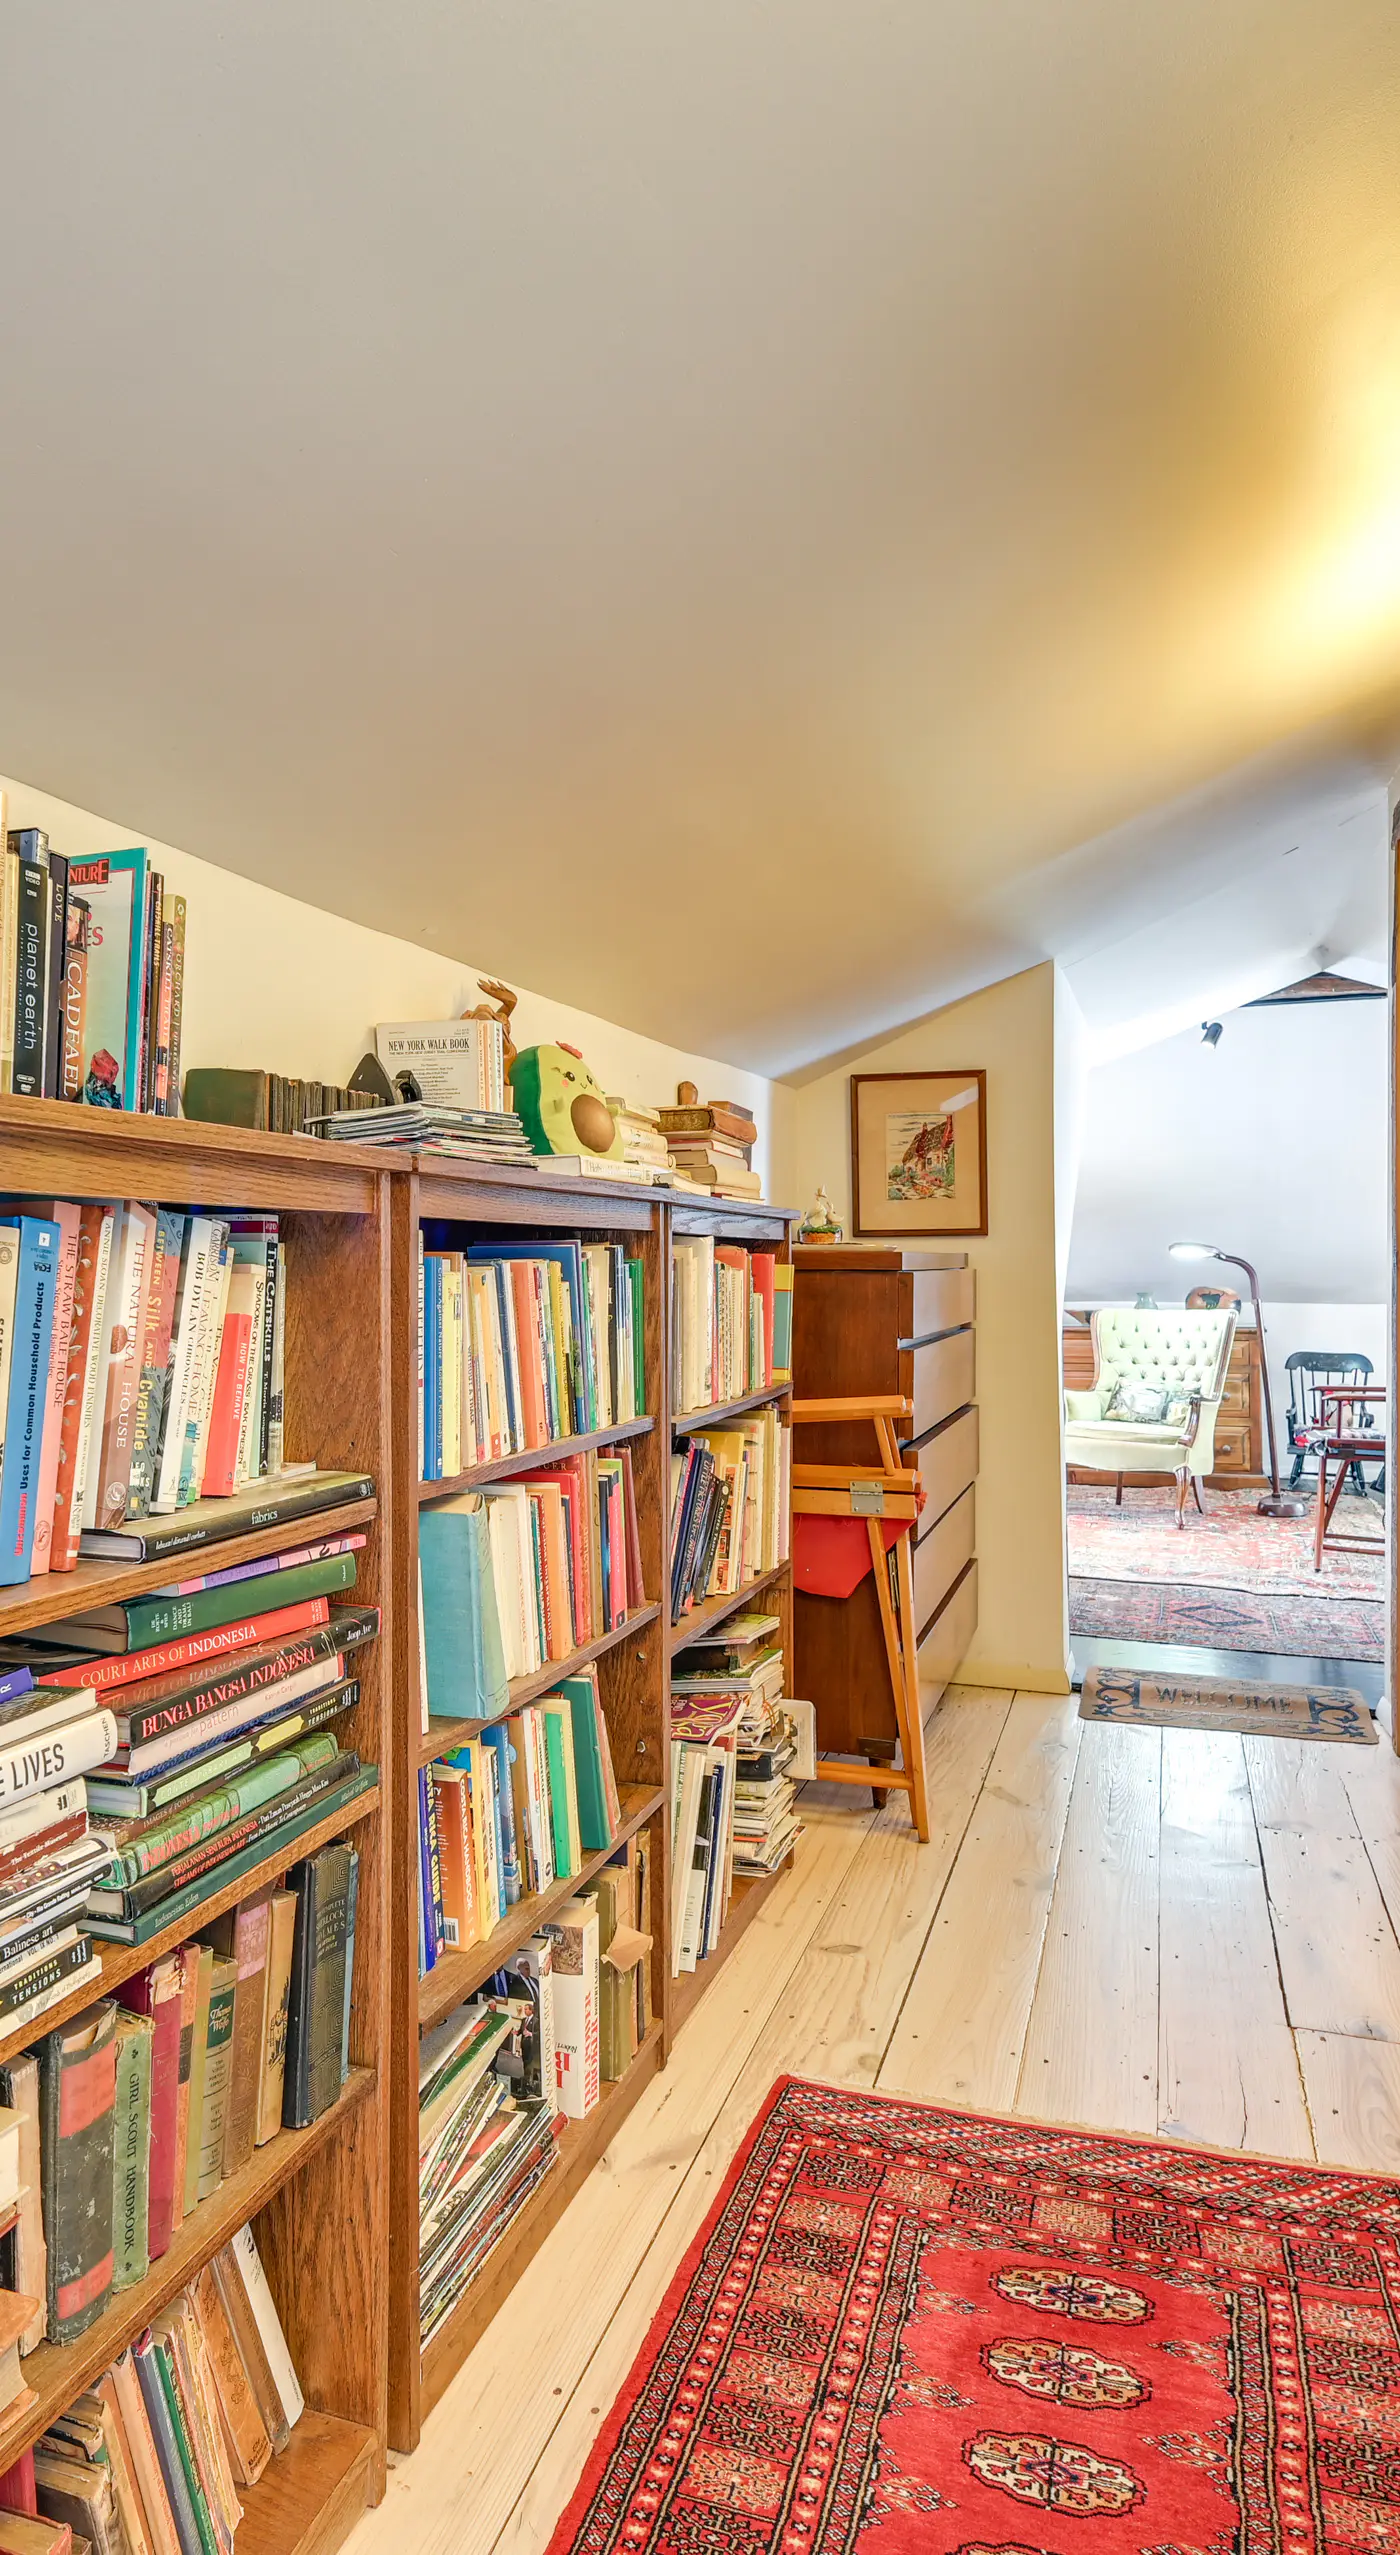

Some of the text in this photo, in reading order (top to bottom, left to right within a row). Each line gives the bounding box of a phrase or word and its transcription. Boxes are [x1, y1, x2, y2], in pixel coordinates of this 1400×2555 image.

[25, 877, 40, 885] VIDEO
[54, 883, 64, 923] LOVE
[153, 900, 162, 966] CATSKILL TRAILS
[163, 928, 173, 993] CATSKILL
[24, 923, 40, 1049] planet earth
[172, 953, 184, 1017] ORCHARD
[64, 961, 82, 1096] CADFAEL
[388, 1037, 470, 1052] NEW YORK WALK BOOK
[207, 1227, 222, 1280] GARRISON
[266, 1247, 277, 1277] THE
[51, 1314, 60, 1331] and
[53, 1234, 78, 1408] THE STRAW BALE HOUSE
[250, 1280, 264, 1329] SHADOWS
[263, 1280, 276, 1362] CATSKILLS
[84, 1223, 112, 1428] ANNIE SLOAN DECORATIVE WOOD FINISHES
[116, 1239, 146, 1449] THE NATURAL HOUSE
[133, 1230, 166, 1450] BETWEEN Silk AND Cyanide
[179, 1252, 206, 1405] BOB DYLAN CHRONICLES
[249, 1331, 258, 1345] ON
[187, 1289, 213, 1416] LEAVING HOME
[248, 1347, 257, 1365] THE
[466, 1346, 474, 1385] WITHOUT
[232, 1342, 248, 1420] HOW TO BEHAVE
[245, 1367, 255, 1398] GRASS
[14, 1281, 45, 1556] Uncommon Uses for Common Household Products
[238, 1424, 249, 1465] DINESEN
[251, 1509, 278, 1525] fabrics
[685, 1460, 710, 1563] LITTLE PICTURES OF JAPAN
[709, 1506, 724, 1557] COFFEE TRADER
[187, 1617, 192, 1627] IN
[543, 1564, 552, 1640] INTERPRETATION
[346, 1624, 372, 1642] Joop Ave
[80, 1662, 128, 1687] COURT
[132, 1651, 165, 1674] ARTS
[168, 1647, 185, 1661] OF
[188, 1625, 257, 1656] INDONESIA
[141, 1700, 193, 1739] BUNGA
[194, 1676, 247, 1715] BANGSA
[249, 1646, 316, 1688] INDONESIA
[309, 1697, 337, 1715] TRADITIONS
[1155, 1685, 1295, 1715] WELCOME
[199, 1704, 240, 1736] pattern
[307, 1705, 338, 1727] TENSIONS
[100, 1717, 112, 1758] TASCHEN
[11, 1743, 65, 1791] LIVES
[504, 1750, 512, 1812] VANCOUVER
[538, 1743, 546, 1800] UNOFFICIAL
[143, 1809, 168, 1829] IMAGES
[174, 1793, 196, 1810] POWER
[231, 1820, 259, 1840] INDONESIA
[10, 1833, 68, 1866] The Textile Museum
[427, 1812, 438, 1853] RICA
[459, 1778, 474, 1911] COSTA RICA HANDBOOK
[430, 1854, 441, 1905] GUIDE
[154, 1893, 199, 1928] Indonesian Eden
[3, 1925, 54, 1959] Balinese art
[12, 1968, 61, 2005] TENSIONS
[13, 1959, 58, 1990] TRADITIONS
[209, 2003, 232, 2020] Thomas
[543, 1989, 551, 2020] BOB
[208, 2017, 230, 2034] Wolfe
[124, 2072, 140, 2254] GIRL SCOUT HANDBOOK
